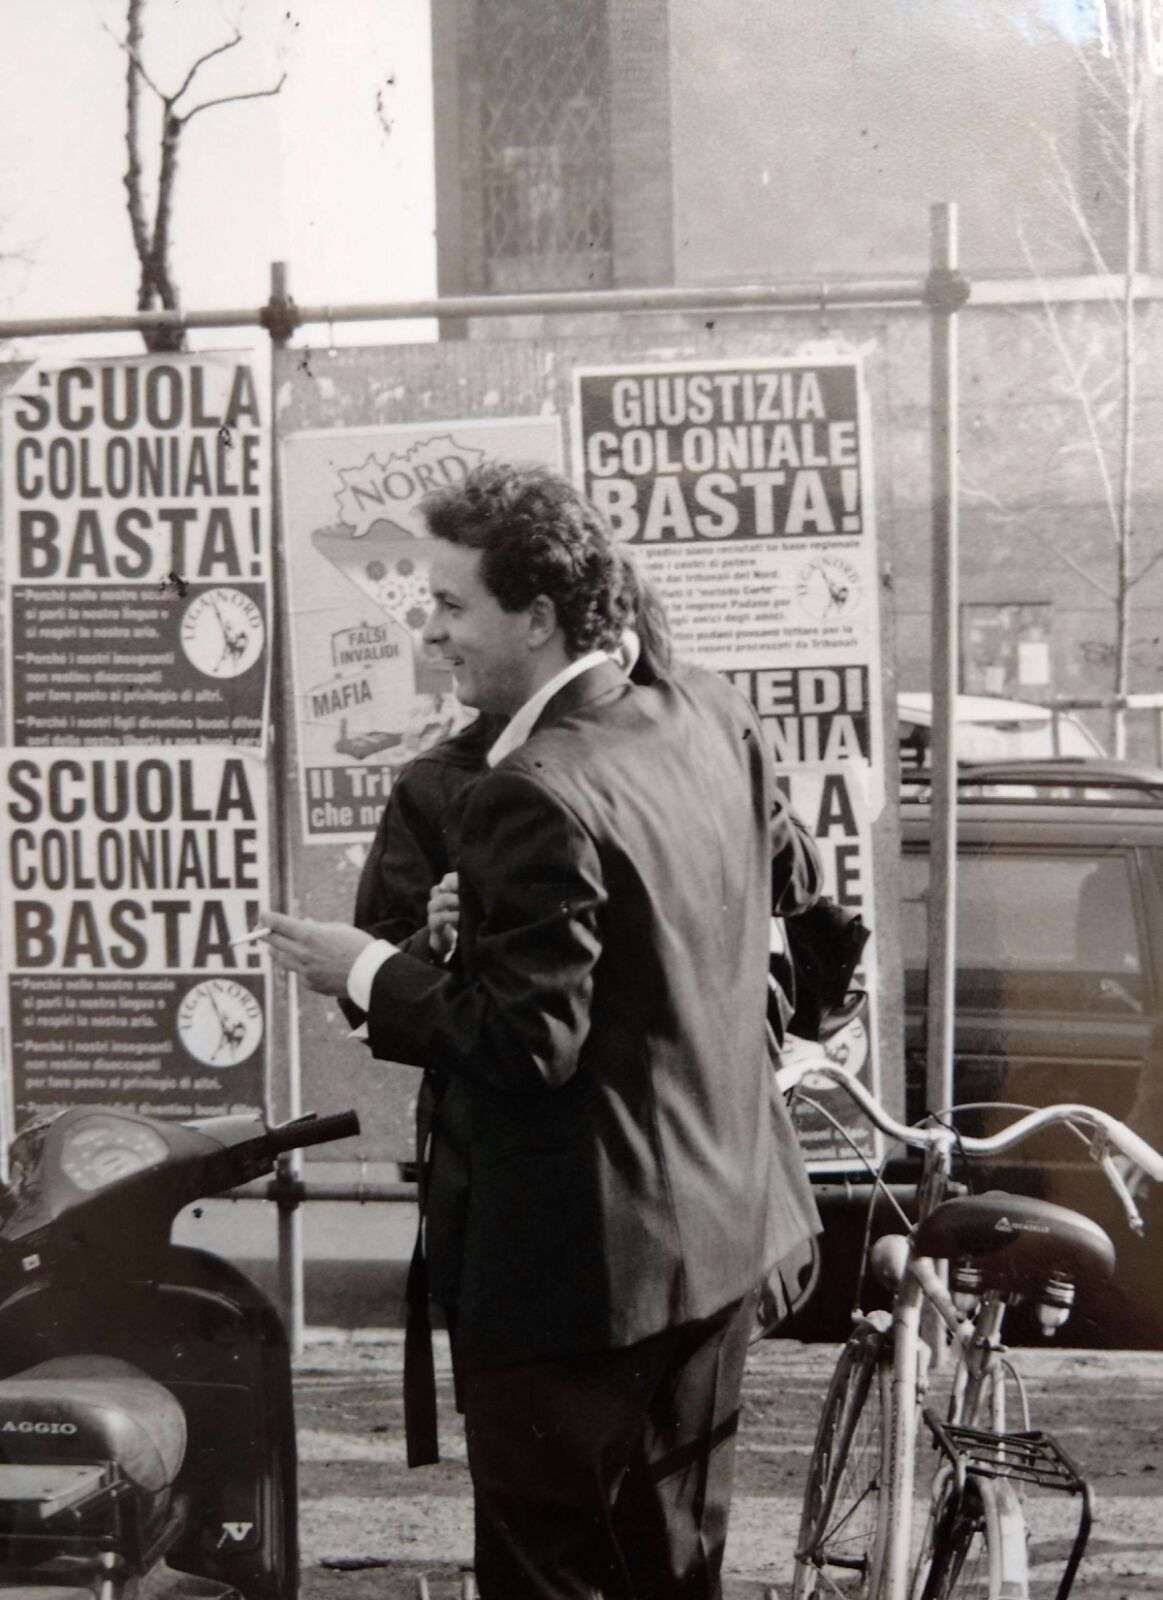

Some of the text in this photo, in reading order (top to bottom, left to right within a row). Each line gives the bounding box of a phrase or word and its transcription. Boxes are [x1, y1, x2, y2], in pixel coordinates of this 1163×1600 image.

[15, 365, 260, 431] SCUOLA
[612, 372, 826, 428] GIUSTIZIA
[16, 435, 261, 500] COLONIALE
[587, 421, 857, 477] COLONIALE
[350, 455, 469, 511] NORD
[591, 469, 861, 543] BASTA!
[19, 507, 261, 578] BASTA!
[340, 643, 399, 664] INVALIDI
[349, 628, 386, 646] FALSI
[312, 679, 373, 718] MAFIA
[8, 759, 256, 823] SCUOLA
[310, 769, 334, 799] Il
[311, 801, 353, 827] che
[10, 828, 258, 890] COLONIALE
[14, 899, 261, 969] BASTA!
[2, 1421, 77, 1434] AGGIO
